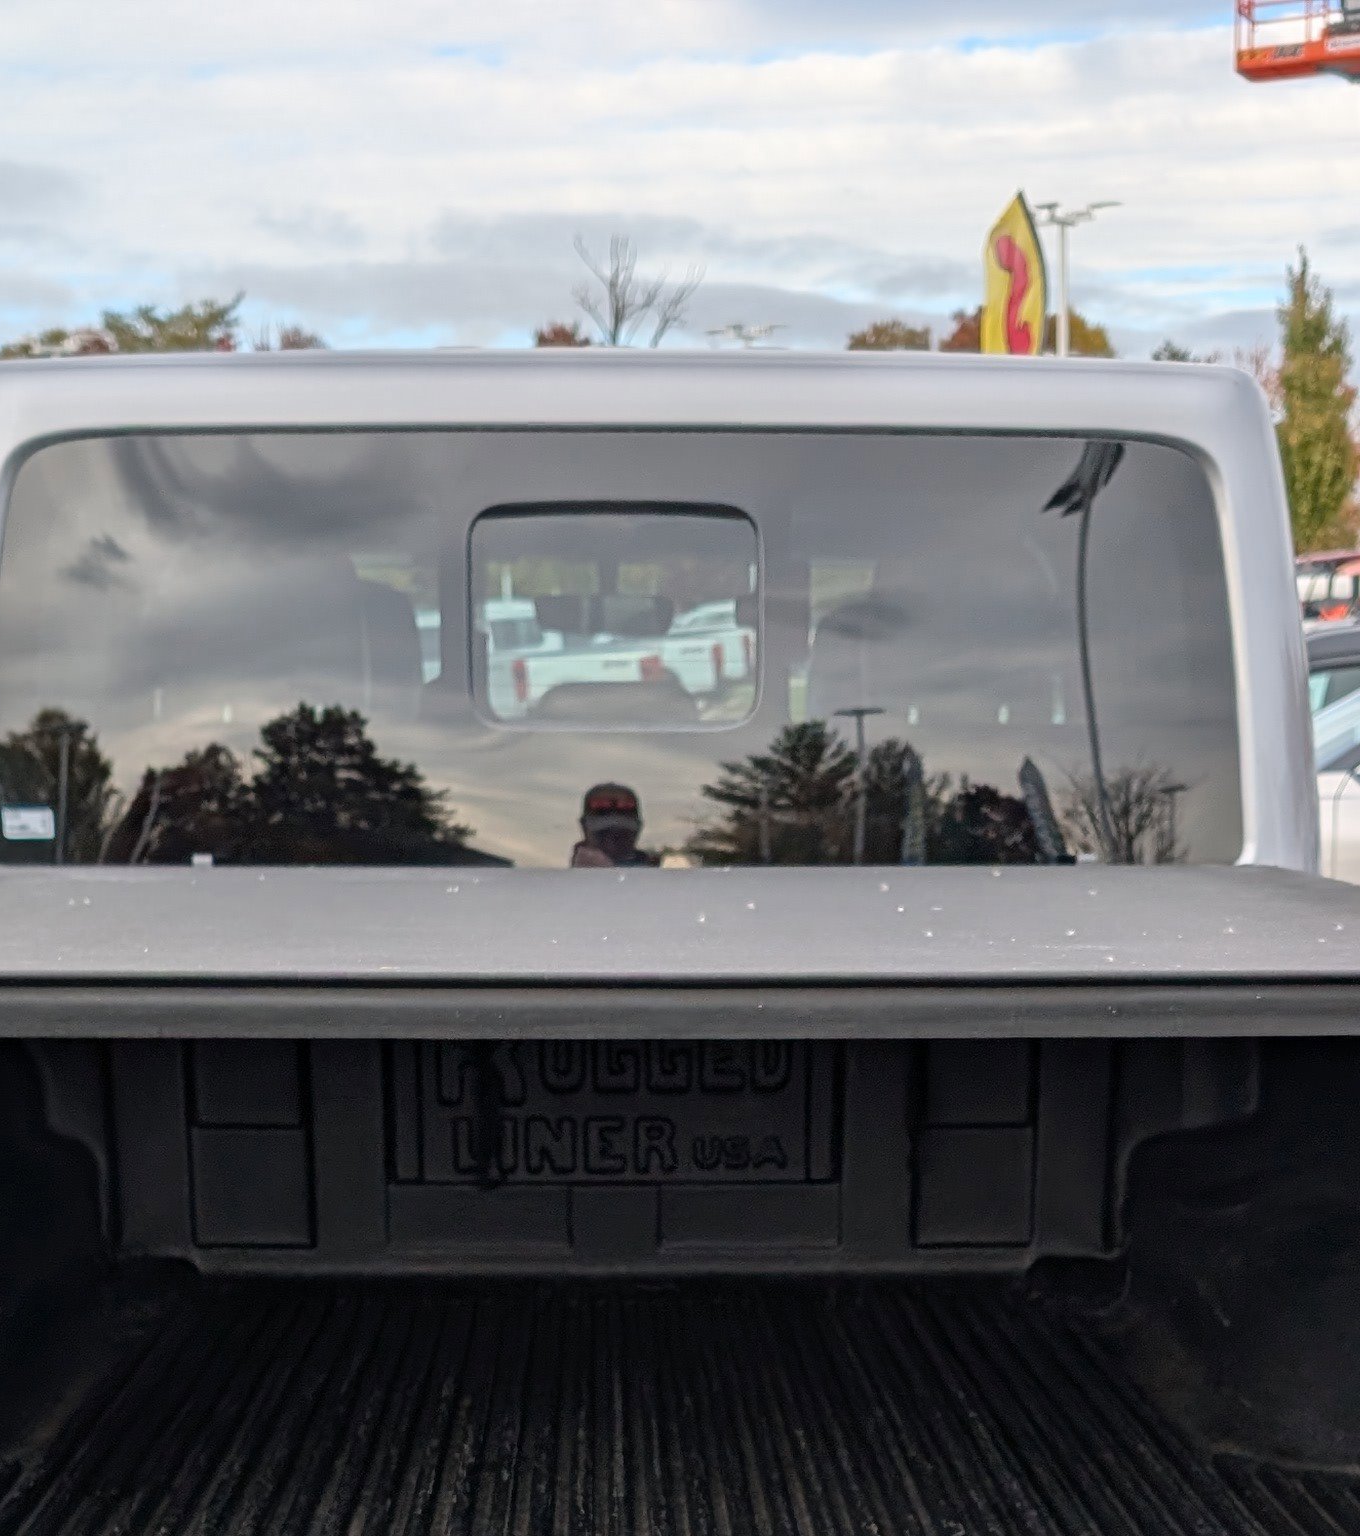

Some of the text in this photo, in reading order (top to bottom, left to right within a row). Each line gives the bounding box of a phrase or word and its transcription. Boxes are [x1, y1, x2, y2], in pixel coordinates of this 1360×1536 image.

[436, 1039, 791, 1106] RUGGED
[451, 1114, 788, 1174] LINER USA
